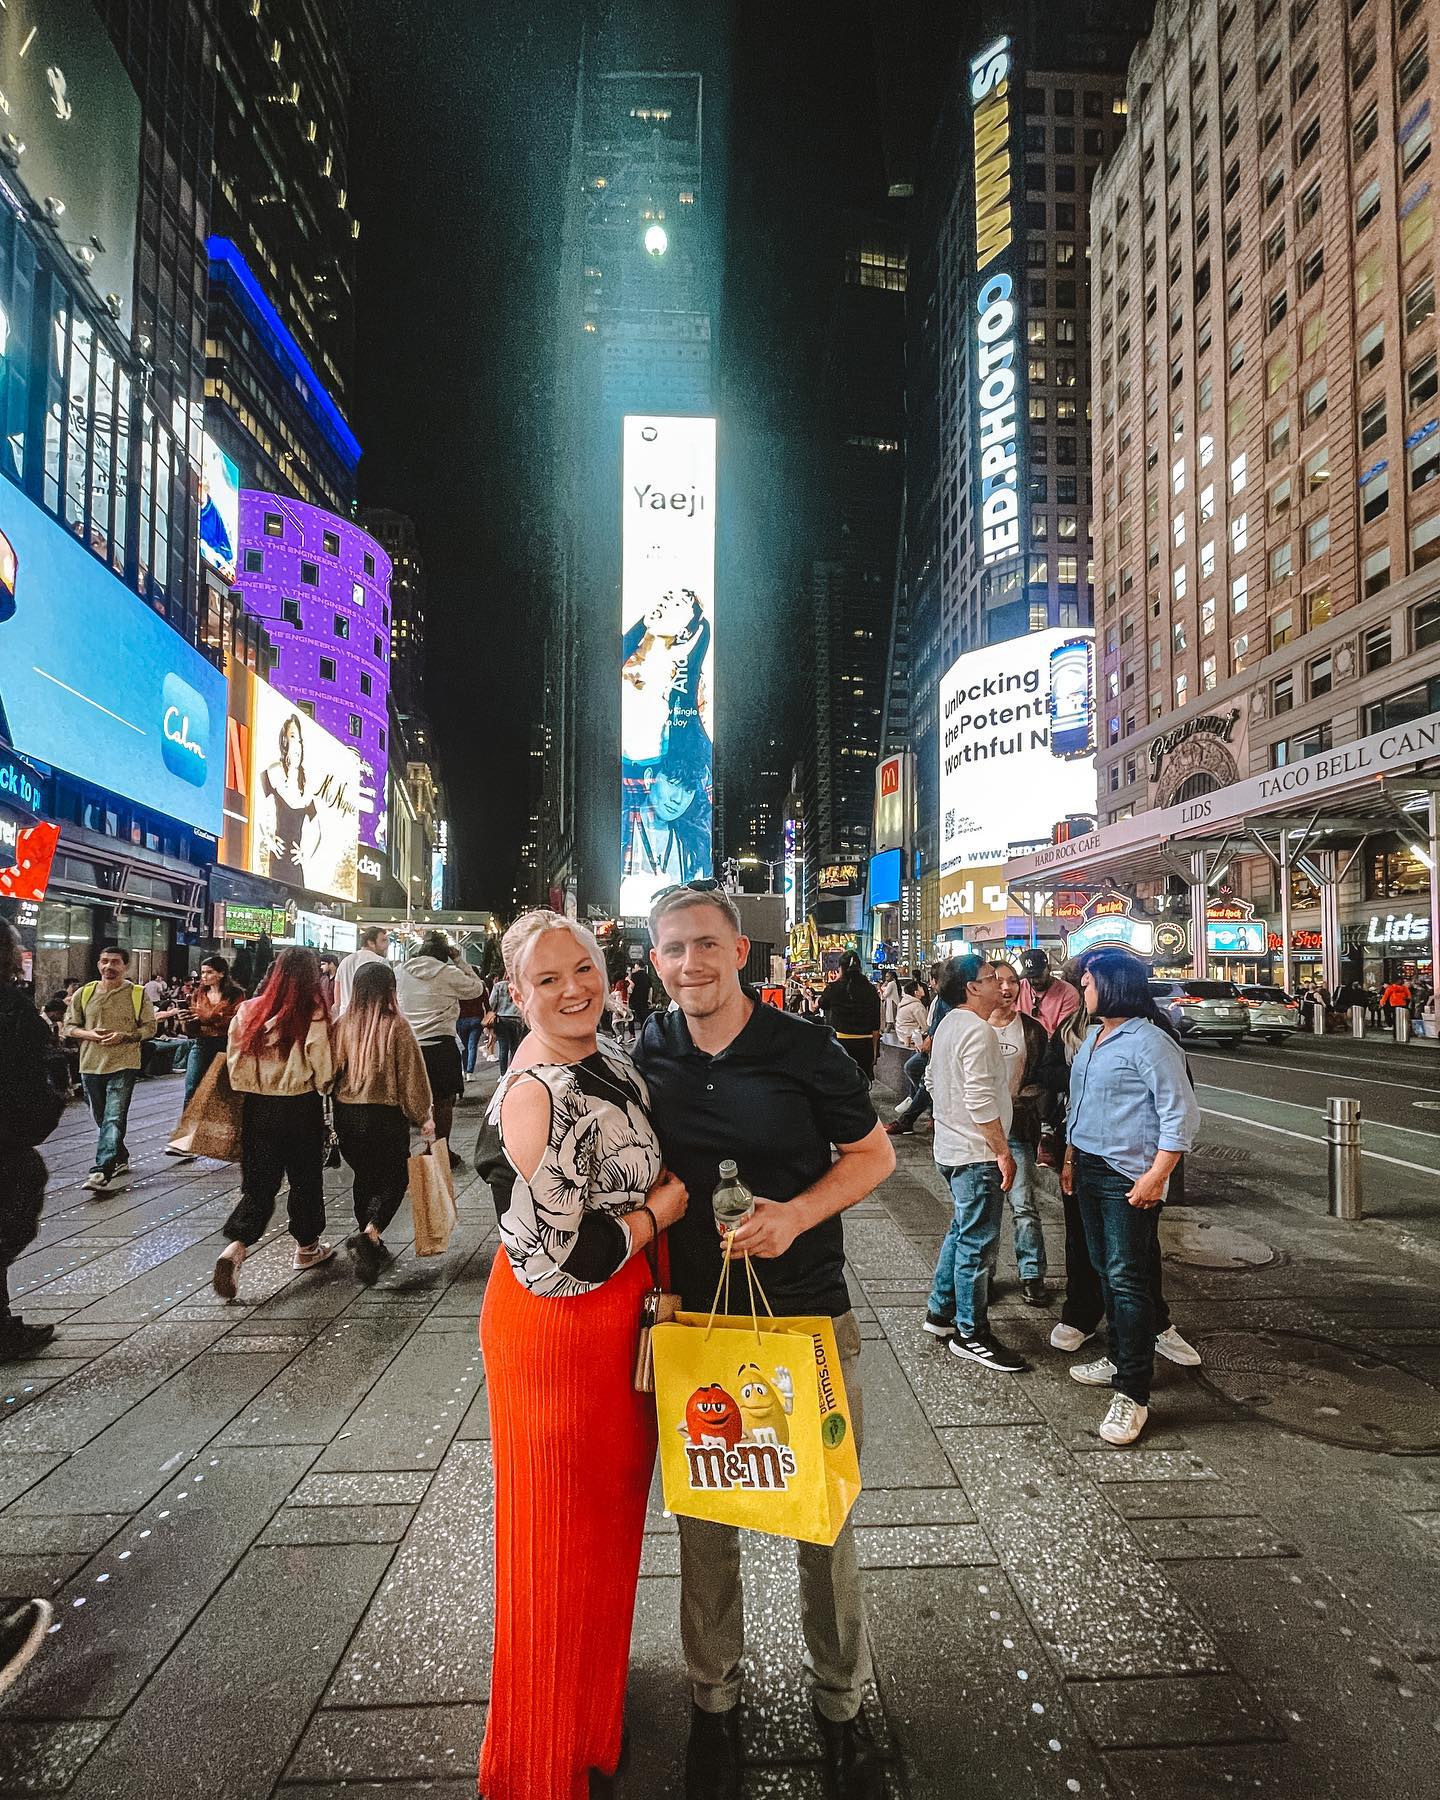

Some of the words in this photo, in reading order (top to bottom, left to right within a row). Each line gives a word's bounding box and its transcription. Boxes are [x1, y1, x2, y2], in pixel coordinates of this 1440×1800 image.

[634, 484, 704, 517] Yaeji
[945, 669, 1040, 719] Unlocking
[164, 705, 206, 760] Calm
[945, 724, 959, 748] the
[1149, 708, 1240, 782] Paramount
[945, 731, 1022, 777] Worthful
[1259, 767, 1309, 799] TACO
[1316, 747, 1373, 782] BELL
[1379, 721, 1440, 760] CAN
[20, 773, 32, 802] to
[1181, 800, 1211, 823] LIDS
[1034, 848, 1055, 867] HARD
[1055, 839, 1077, 860] ROCK
[1078, 834, 1101, 852] CAFE
[358, 855, 381, 881] daq
[901, 885, 909, 921] SQUARE
[901, 929, 909, 957] TIMES
[1366, 913, 1429, 943] Lids
